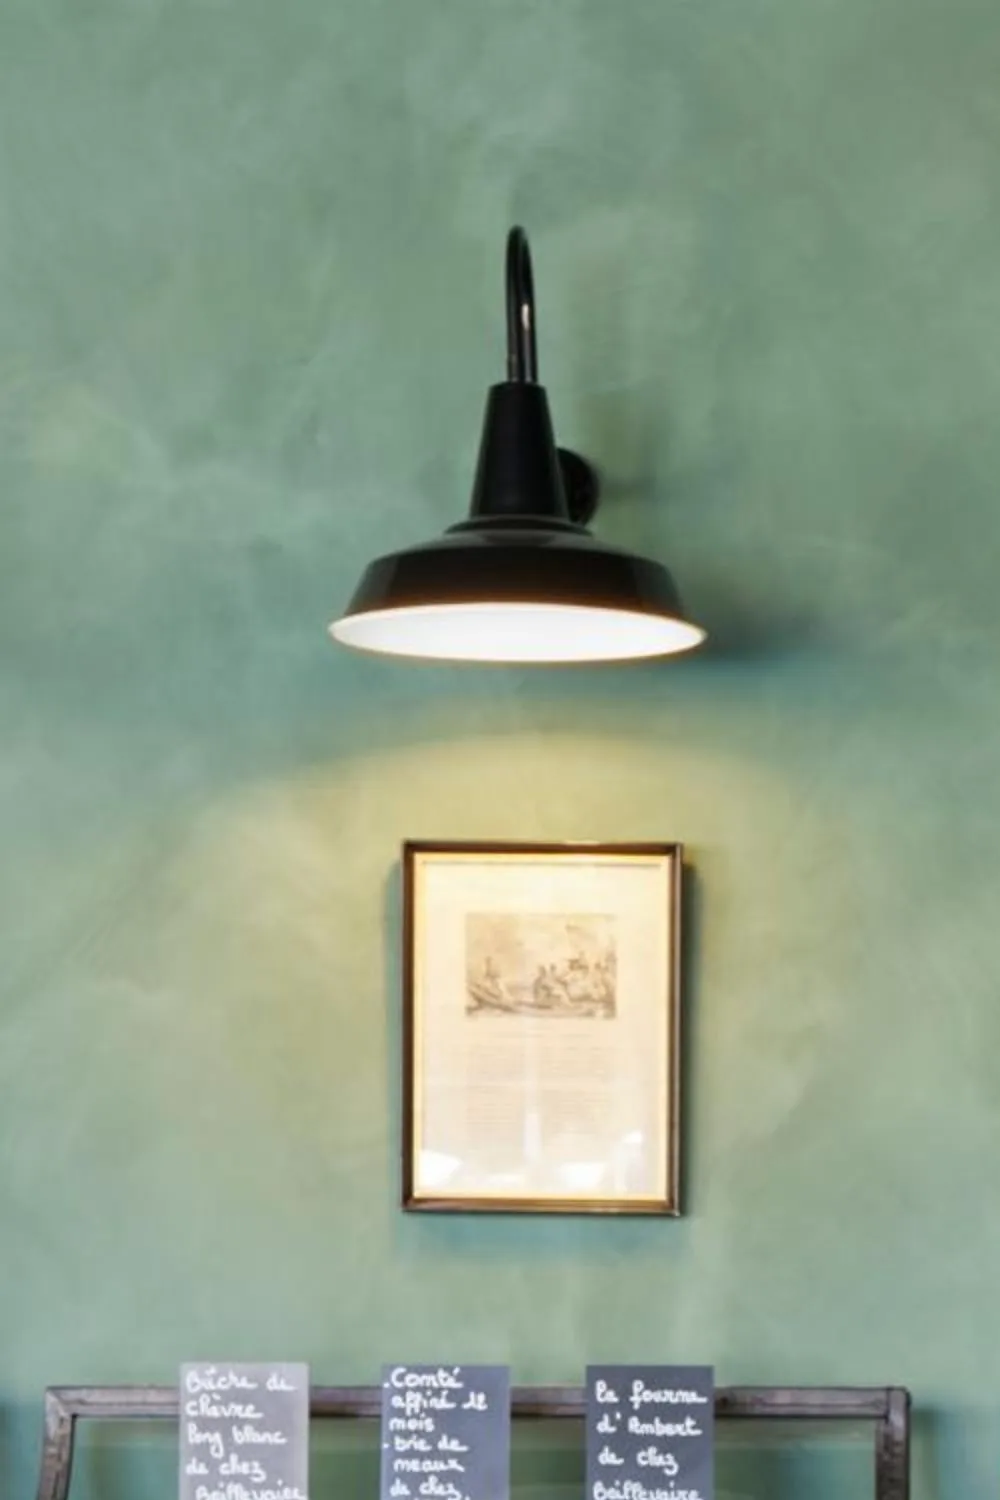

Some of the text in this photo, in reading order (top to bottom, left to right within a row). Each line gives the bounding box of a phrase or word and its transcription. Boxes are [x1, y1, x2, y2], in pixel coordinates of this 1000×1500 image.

[266, 1373, 297, 1391] de
[391, 1367, 464, 1389] Comté
[389, 1413, 435, 1432] mois
[437, 1434, 469, 1451] de
[185, 1453, 267, 1482] de chez
[598, 1446, 679, 1477] de chez
[389, 1478, 410, 1496] de
